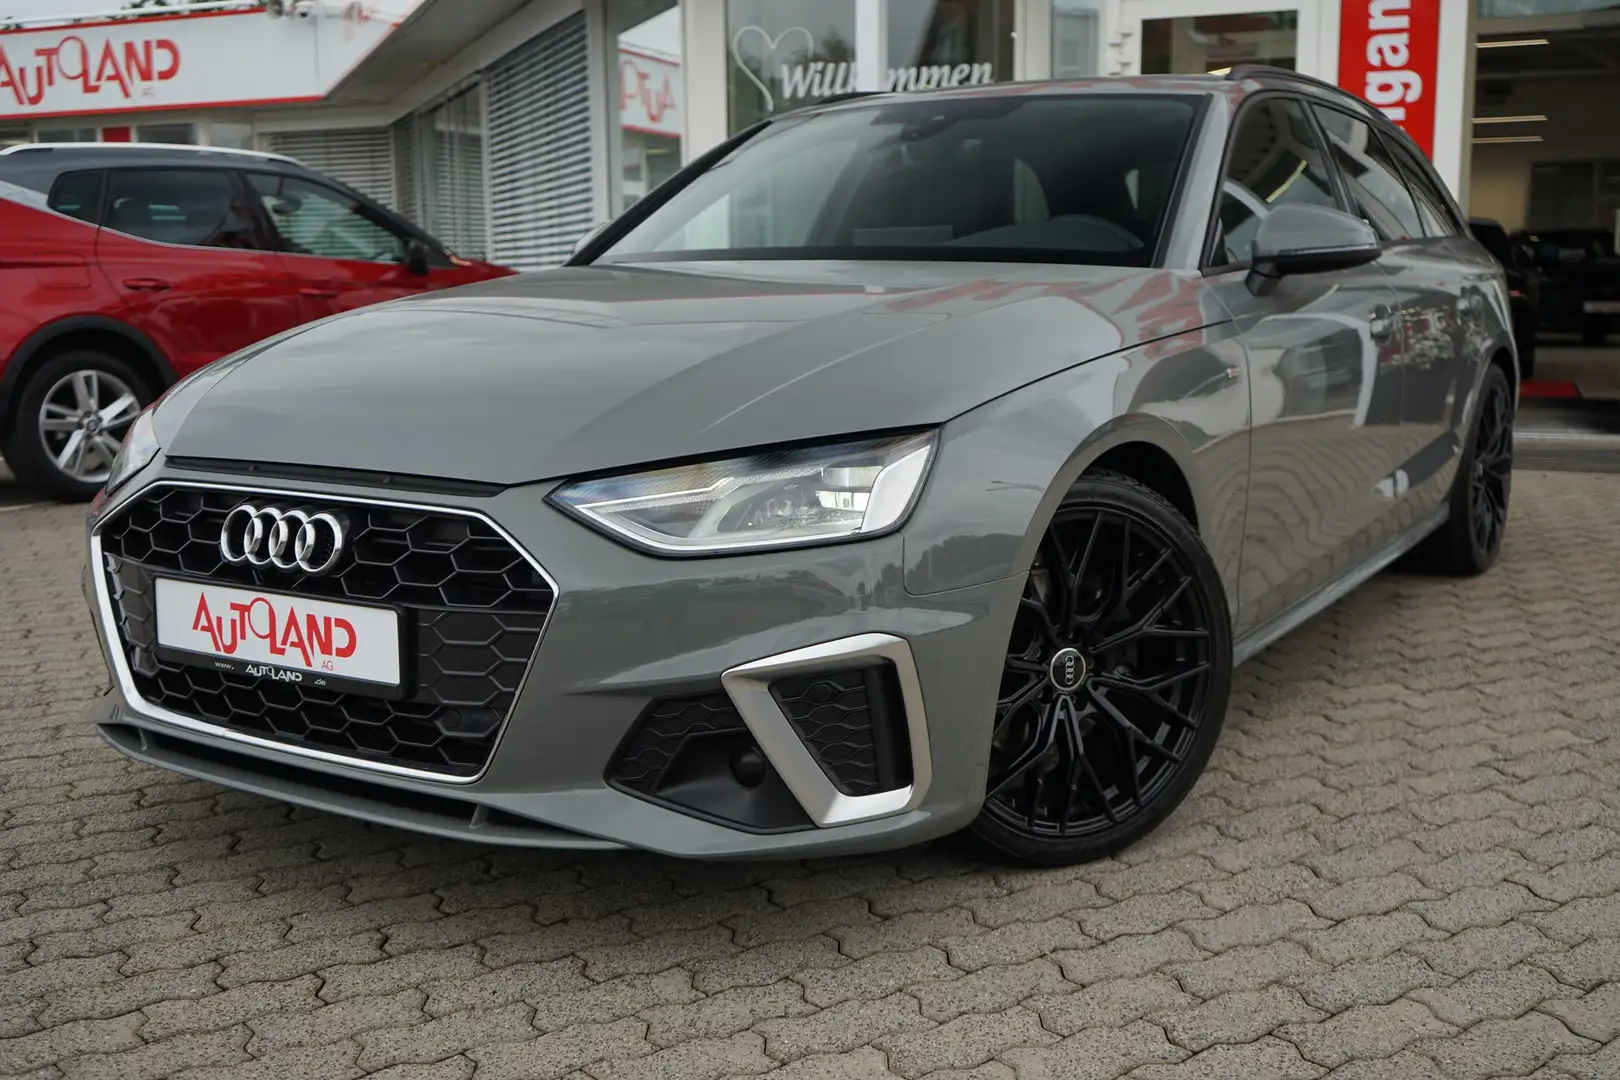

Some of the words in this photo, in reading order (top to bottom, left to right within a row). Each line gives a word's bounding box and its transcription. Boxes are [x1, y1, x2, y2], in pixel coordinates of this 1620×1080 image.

[782, 61, 994, 99] Willmmen
[1364, 0, 1423, 131] gan
[192, 592, 357, 667] AUTOLAND
[245, 664, 303, 682] AUTOLAND
[321, 660, 334, 671] AG
